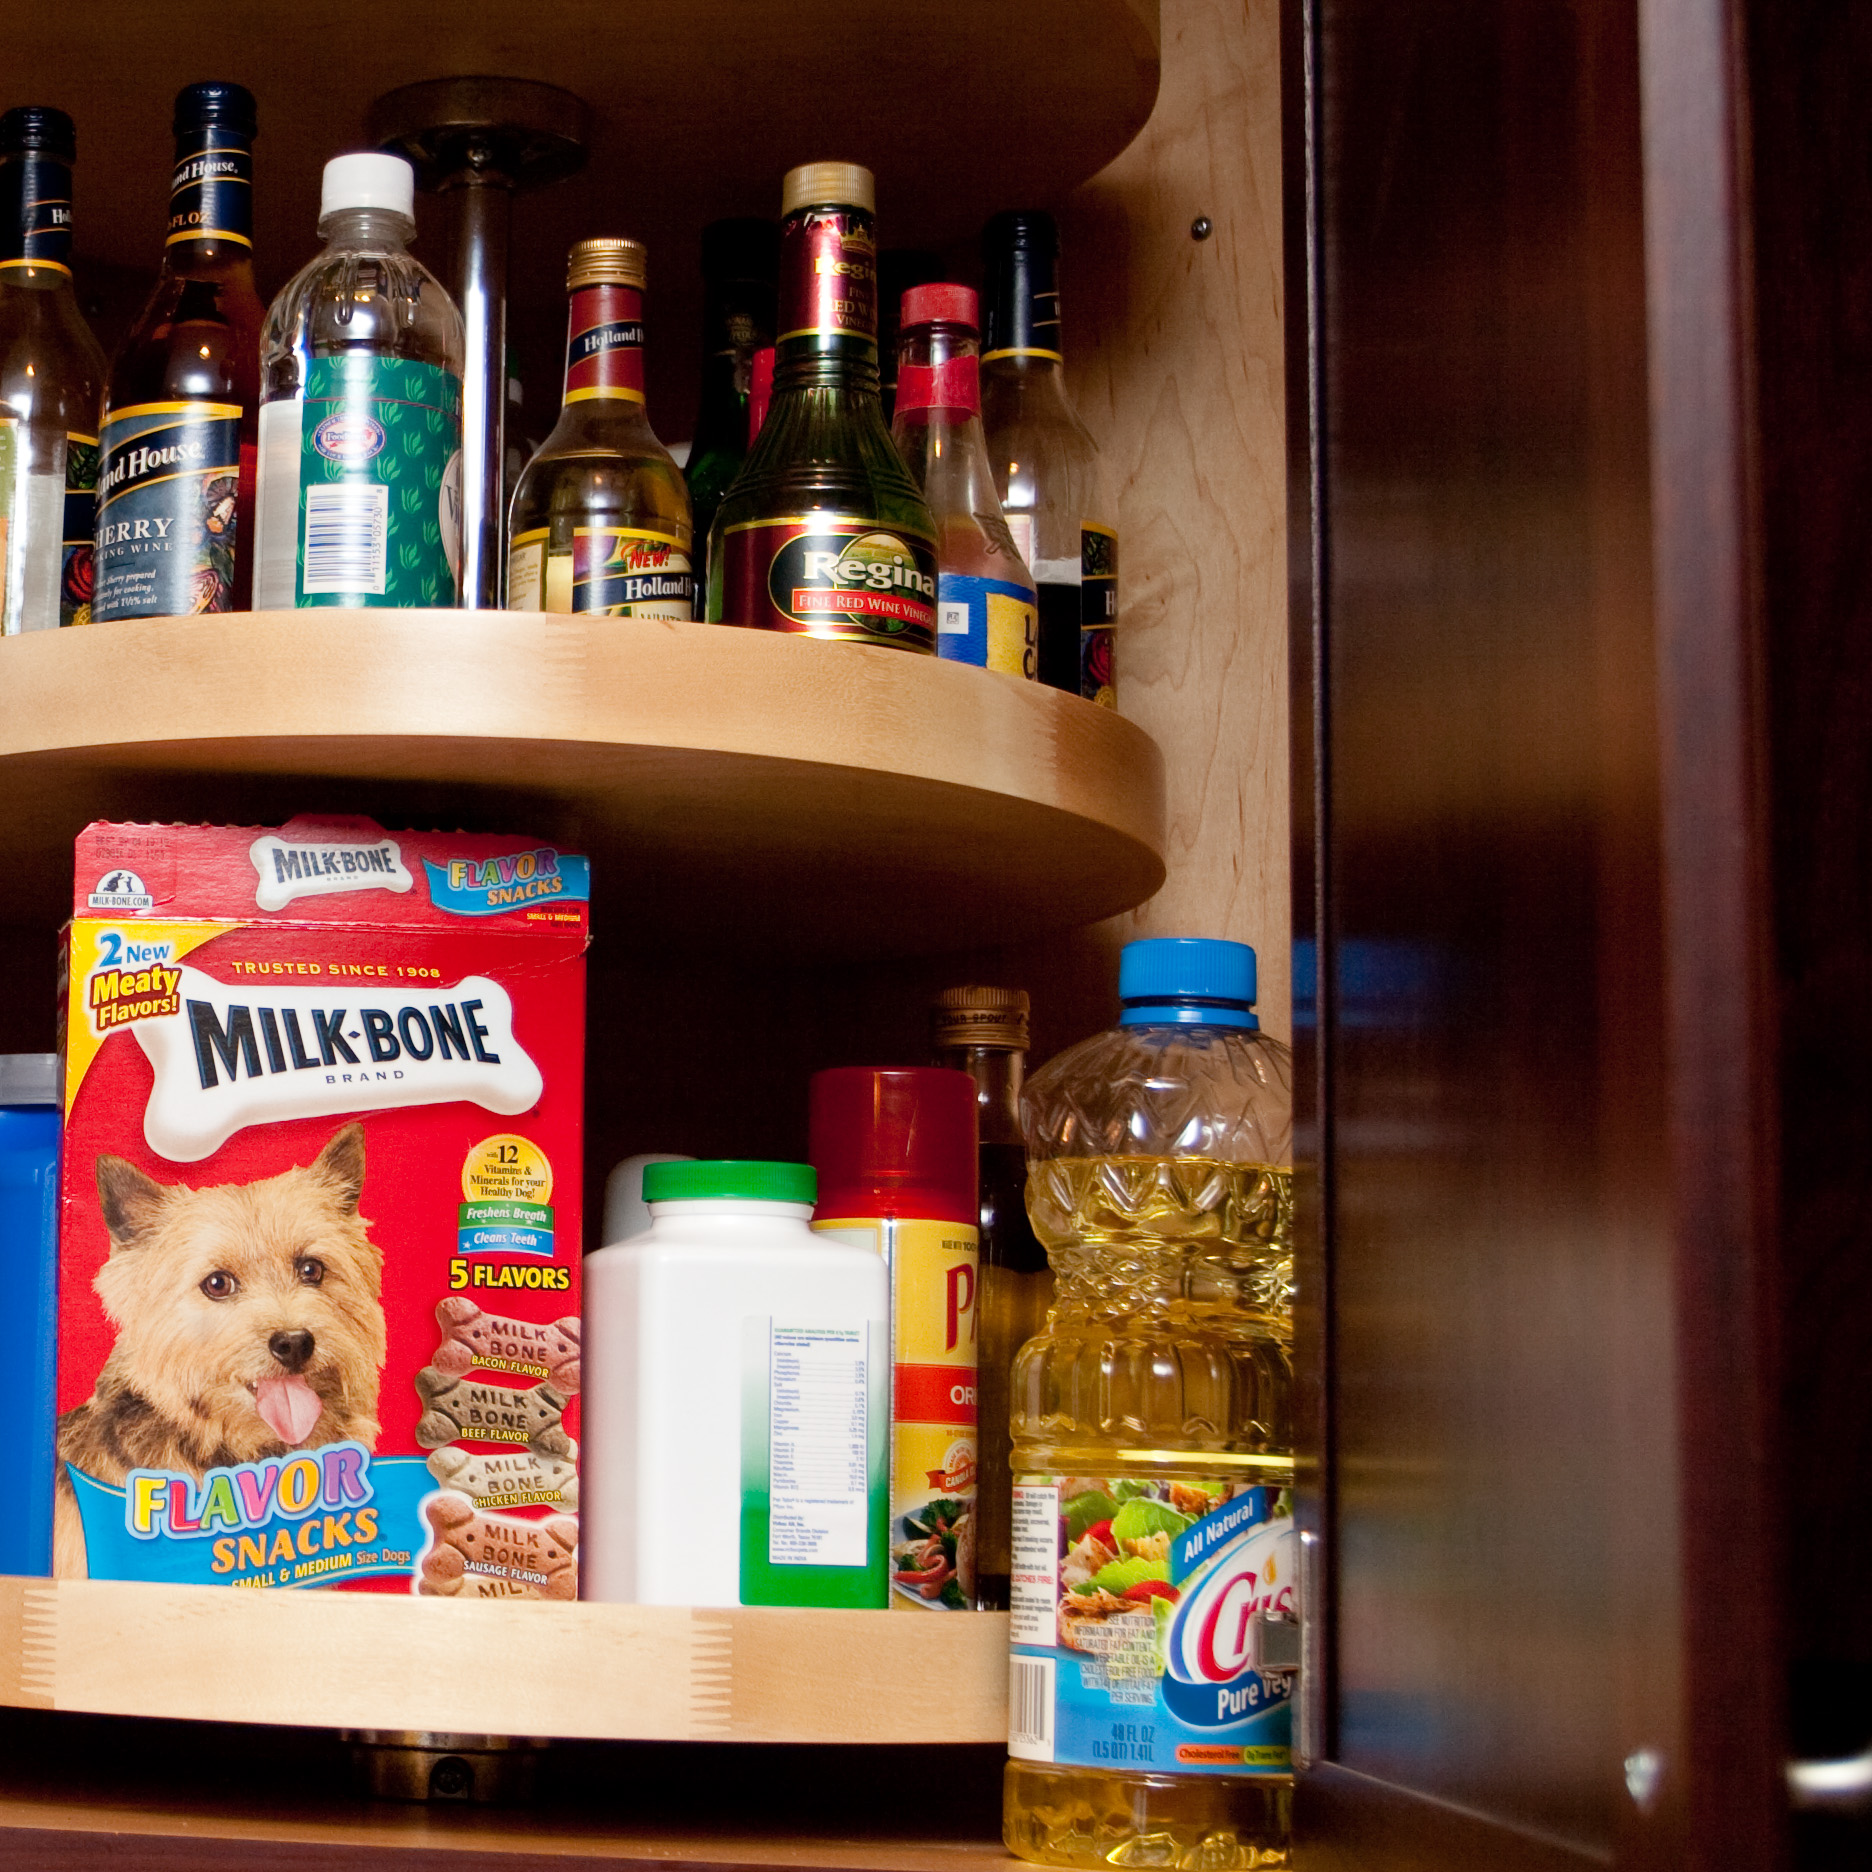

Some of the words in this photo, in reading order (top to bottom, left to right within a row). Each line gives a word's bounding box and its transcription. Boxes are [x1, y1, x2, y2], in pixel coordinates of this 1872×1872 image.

[192, 160, 234, 177] House
[584, 329, 636, 353] Holland
[128, 441, 202, 480] House
[131, 542, 173, 555] WINE
[629, 545, 672, 570] NEW!
[126, 569, 157, 583] prepared
[803, 551, 936, 599] Regina
[124, 583, 155, 595] cooking.
[142, 594, 158, 605] salt
[625, 577, 685, 601] Holland
[799, 594, 831, 608] FINE
[836, 594, 865, 610] RED
[867, 597, 902, 616] WINE
[272, 846, 398, 884] MILK-BONE
[450, 848, 558, 889] FLAVOR
[92, 896, 150, 907] MILK-BONE.COM
[487, 876, 562, 906] SNACKS
[99, 932, 123, 967] 2
[126, 945, 170, 964] New
[232, 961, 322, 975] TRUSTED
[328, 963, 389, 977] SINCE
[397, 966, 441, 978] 1908
[93, 964, 181, 1005] Meaty
[99, 994, 178, 1028] Flavors!
[325, 1070, 405, 1084] BRAND
[498, 1145, 519, 1164] 12
[484, 1164, 522, 1176] Vitamins
[523, 1165, 532, 1176] &
[469, 1174, 510, 1186] Minerals
[511, 1175, 525, 1186] for
[526, 1178, 546, 1189] your
[480, 1186, 513, 1199] Healthy
[515, 1187, 535, 1200] Dog!
[466, 1207, 511, 1220] Freshens
[513, 1207, 547, 1223] Breath
[474, 1232, 508, 1244] Cleans
[511, 1231, 538, 1247] Teeth
[449, 1258, 470, 1290] 5
[473, 1264, 572, 1290] FLAVORS
[491, 1321, 547, 1342] MILK
[490, 1340, 548, 1363] BONE
[471, 1354, 507, 1370] BACON
[510, 1361, 549, 1378] FLAVOR
[471, 1389, 528, 1410] MILK
[470, 1408, 527, 1430] BONE
[461, 1427, 487, 1439] BEEF
[490, 1428, 530, 1443] FLAVOR
[484, 1456, 542, 1475] MILK
[132, 1447, 367, 1533] FLAVOR
[487, 1475, 546, 1495] BONE
[472, 1493, 518, 1509] CHICKEN
[521, 1490, 562, 1503] FLAVOR
[485, 1524, 540, 1549] MILK
[1183, 1533, 1204, 1563] All
[1206, 1497, 1255, 1547] Natural
[210, 1507, 380, 1575] SNACKS
[231, 1570, 277, 1589] SMALL
[279, 1567, 291, 1583] &
[294, 1552, 353, 1580] MEDIUM
[356, 1549, 379, 1566] Size
[382, 1547, 412, 1566] Dogs
[482, 1545, 537, 1570] BONE
[463, 1560, 508, 1577] SAUSAGE
[511, 1568, 549, 1586] FLAVOR
[477, 1581, 534, 1598] MIL
[1110, 1640, 1121, 1650] FAT
[1122, 1665, 1137, 1677] FREE
[1217, 1683, 1259, 1720] Pure
[1112, 1722, 1125, 1742] 48
[1127, 1724, 1138, 1742] FL
[1141, 1725, 1156, 1743] OZ
[1179, 1747, 1224, 1760] Cholesterol
[1225, 1749, 1240, 1760] Free
